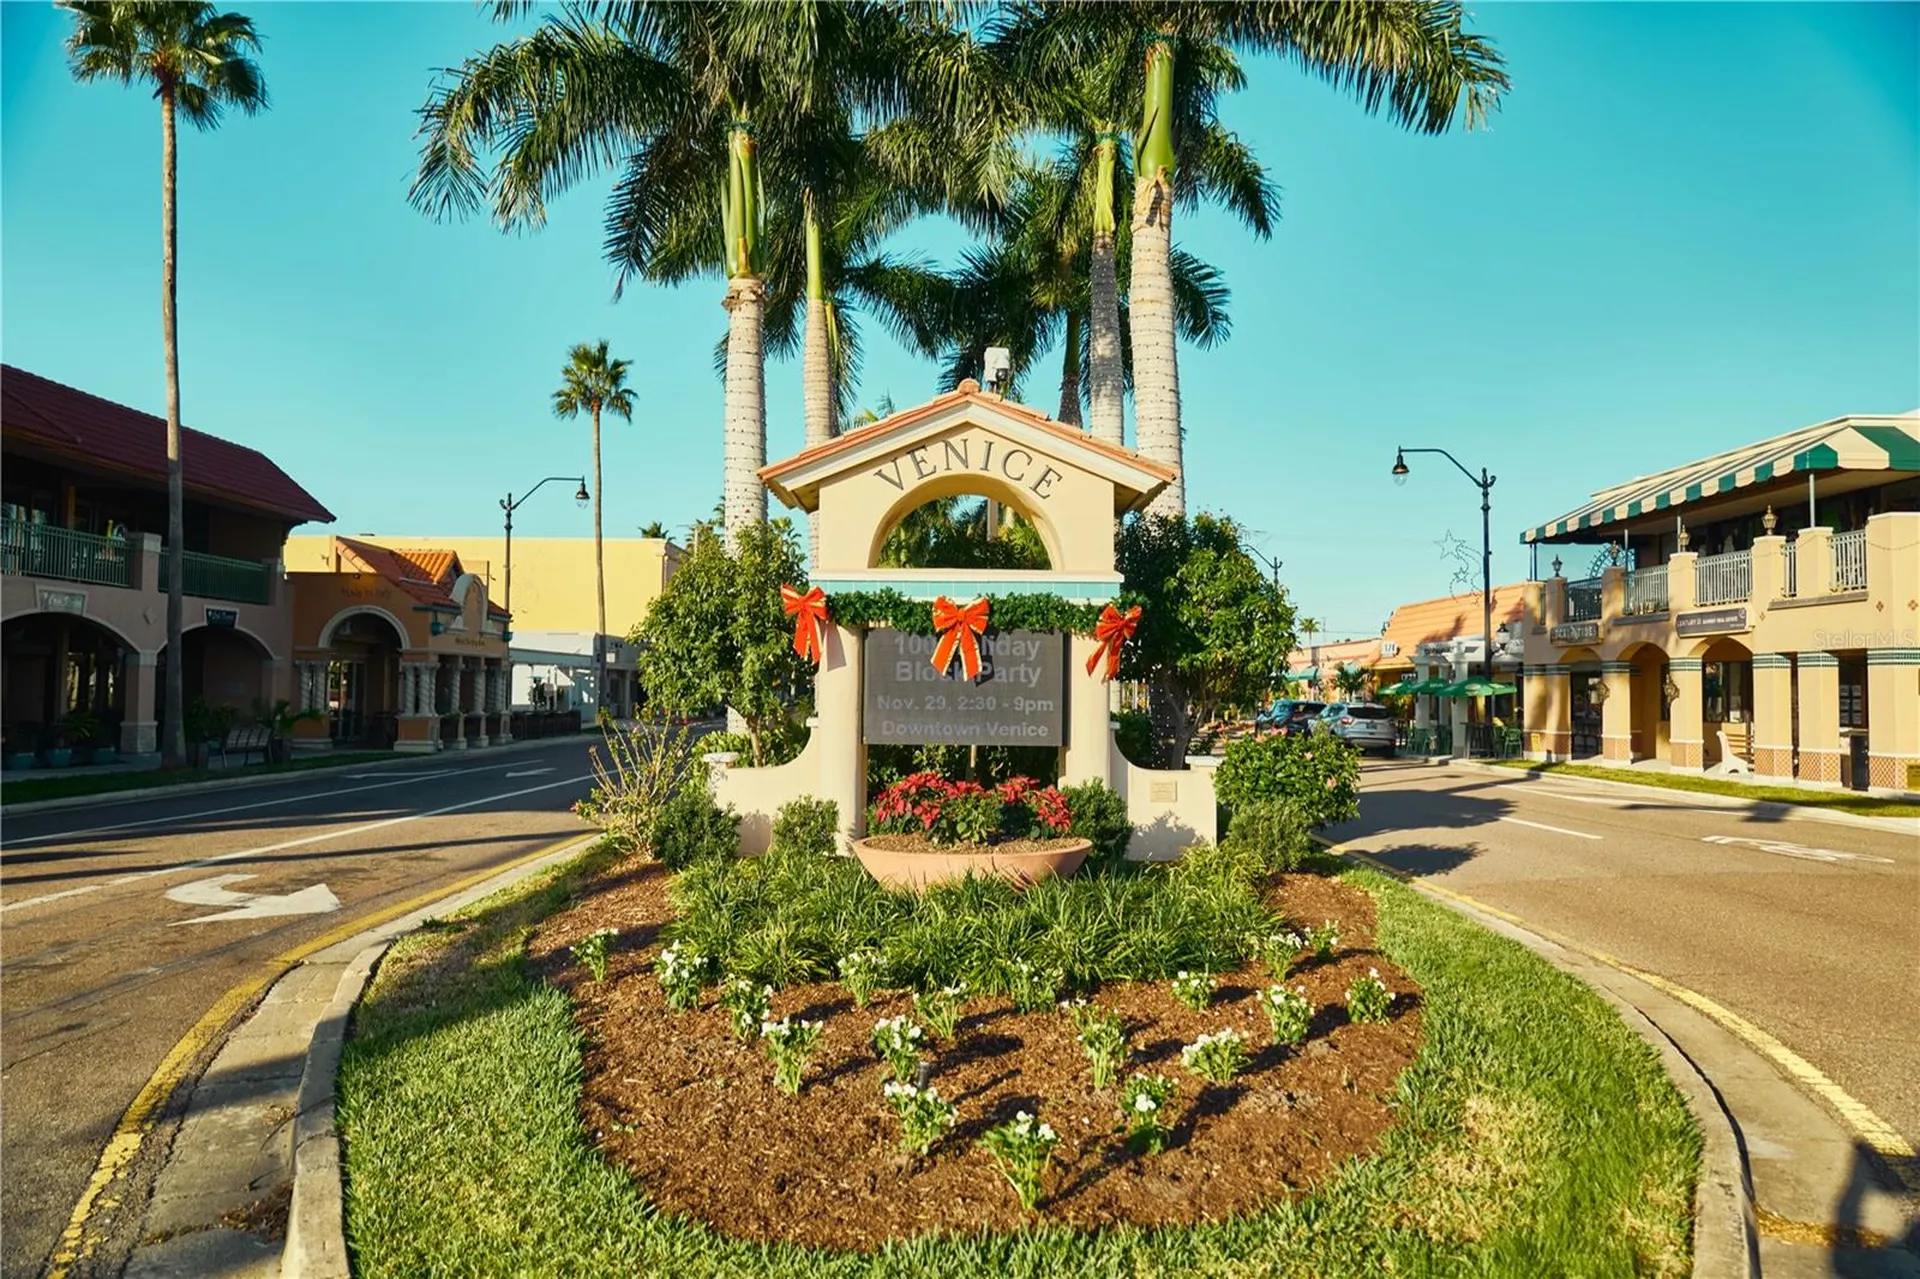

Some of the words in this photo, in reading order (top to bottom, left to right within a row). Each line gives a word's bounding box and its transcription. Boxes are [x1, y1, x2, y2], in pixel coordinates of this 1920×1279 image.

[873, 438, 1063, 500] VENICE
[980, 634, 1041, 661] liday
[976, 661, 1042, 688] Party
[877, 695, 920, 710] Nov.
[957, 695, 997, 711] 2:30
[1013, 696, 1054, 715] 9pm
[882, 720, 980, 736] Downtown
[986, 721, 1049, 737] Venice
